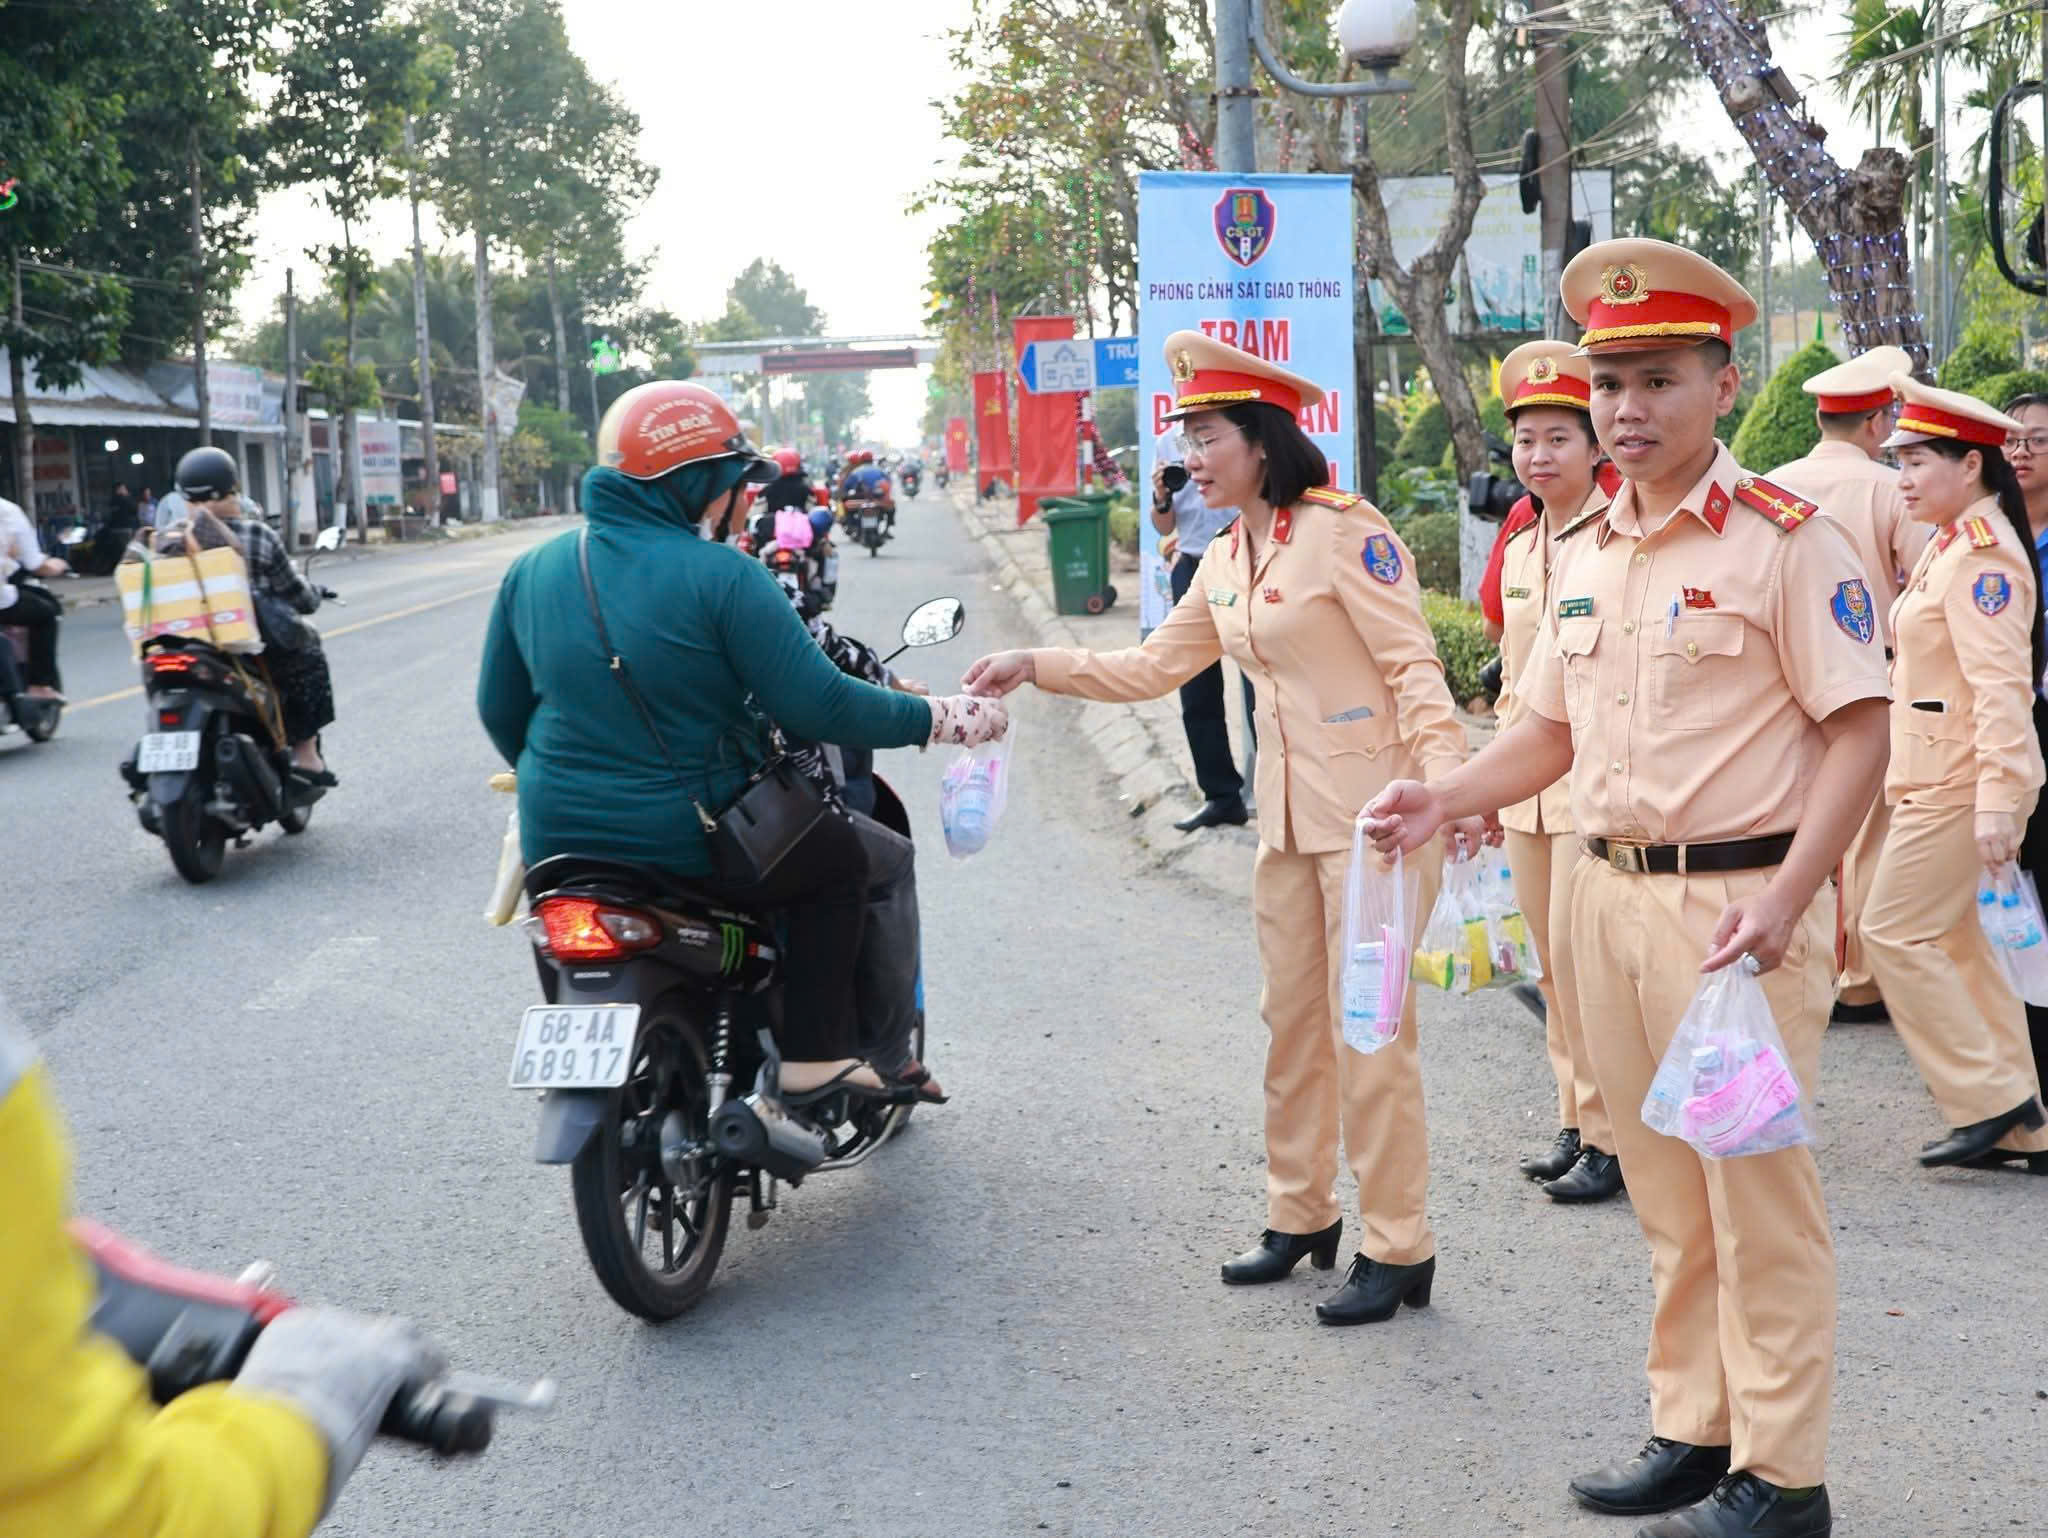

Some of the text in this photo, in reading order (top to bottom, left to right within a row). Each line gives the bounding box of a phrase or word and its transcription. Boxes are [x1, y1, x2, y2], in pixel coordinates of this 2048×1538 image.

[1149, 276, 1342, 301] PHÒNG CẢNH SÁT GIAO THÔNG
[538, 1010, 617, 1045] 68-AA
[517, 1047, 624, 1082] 689.17
